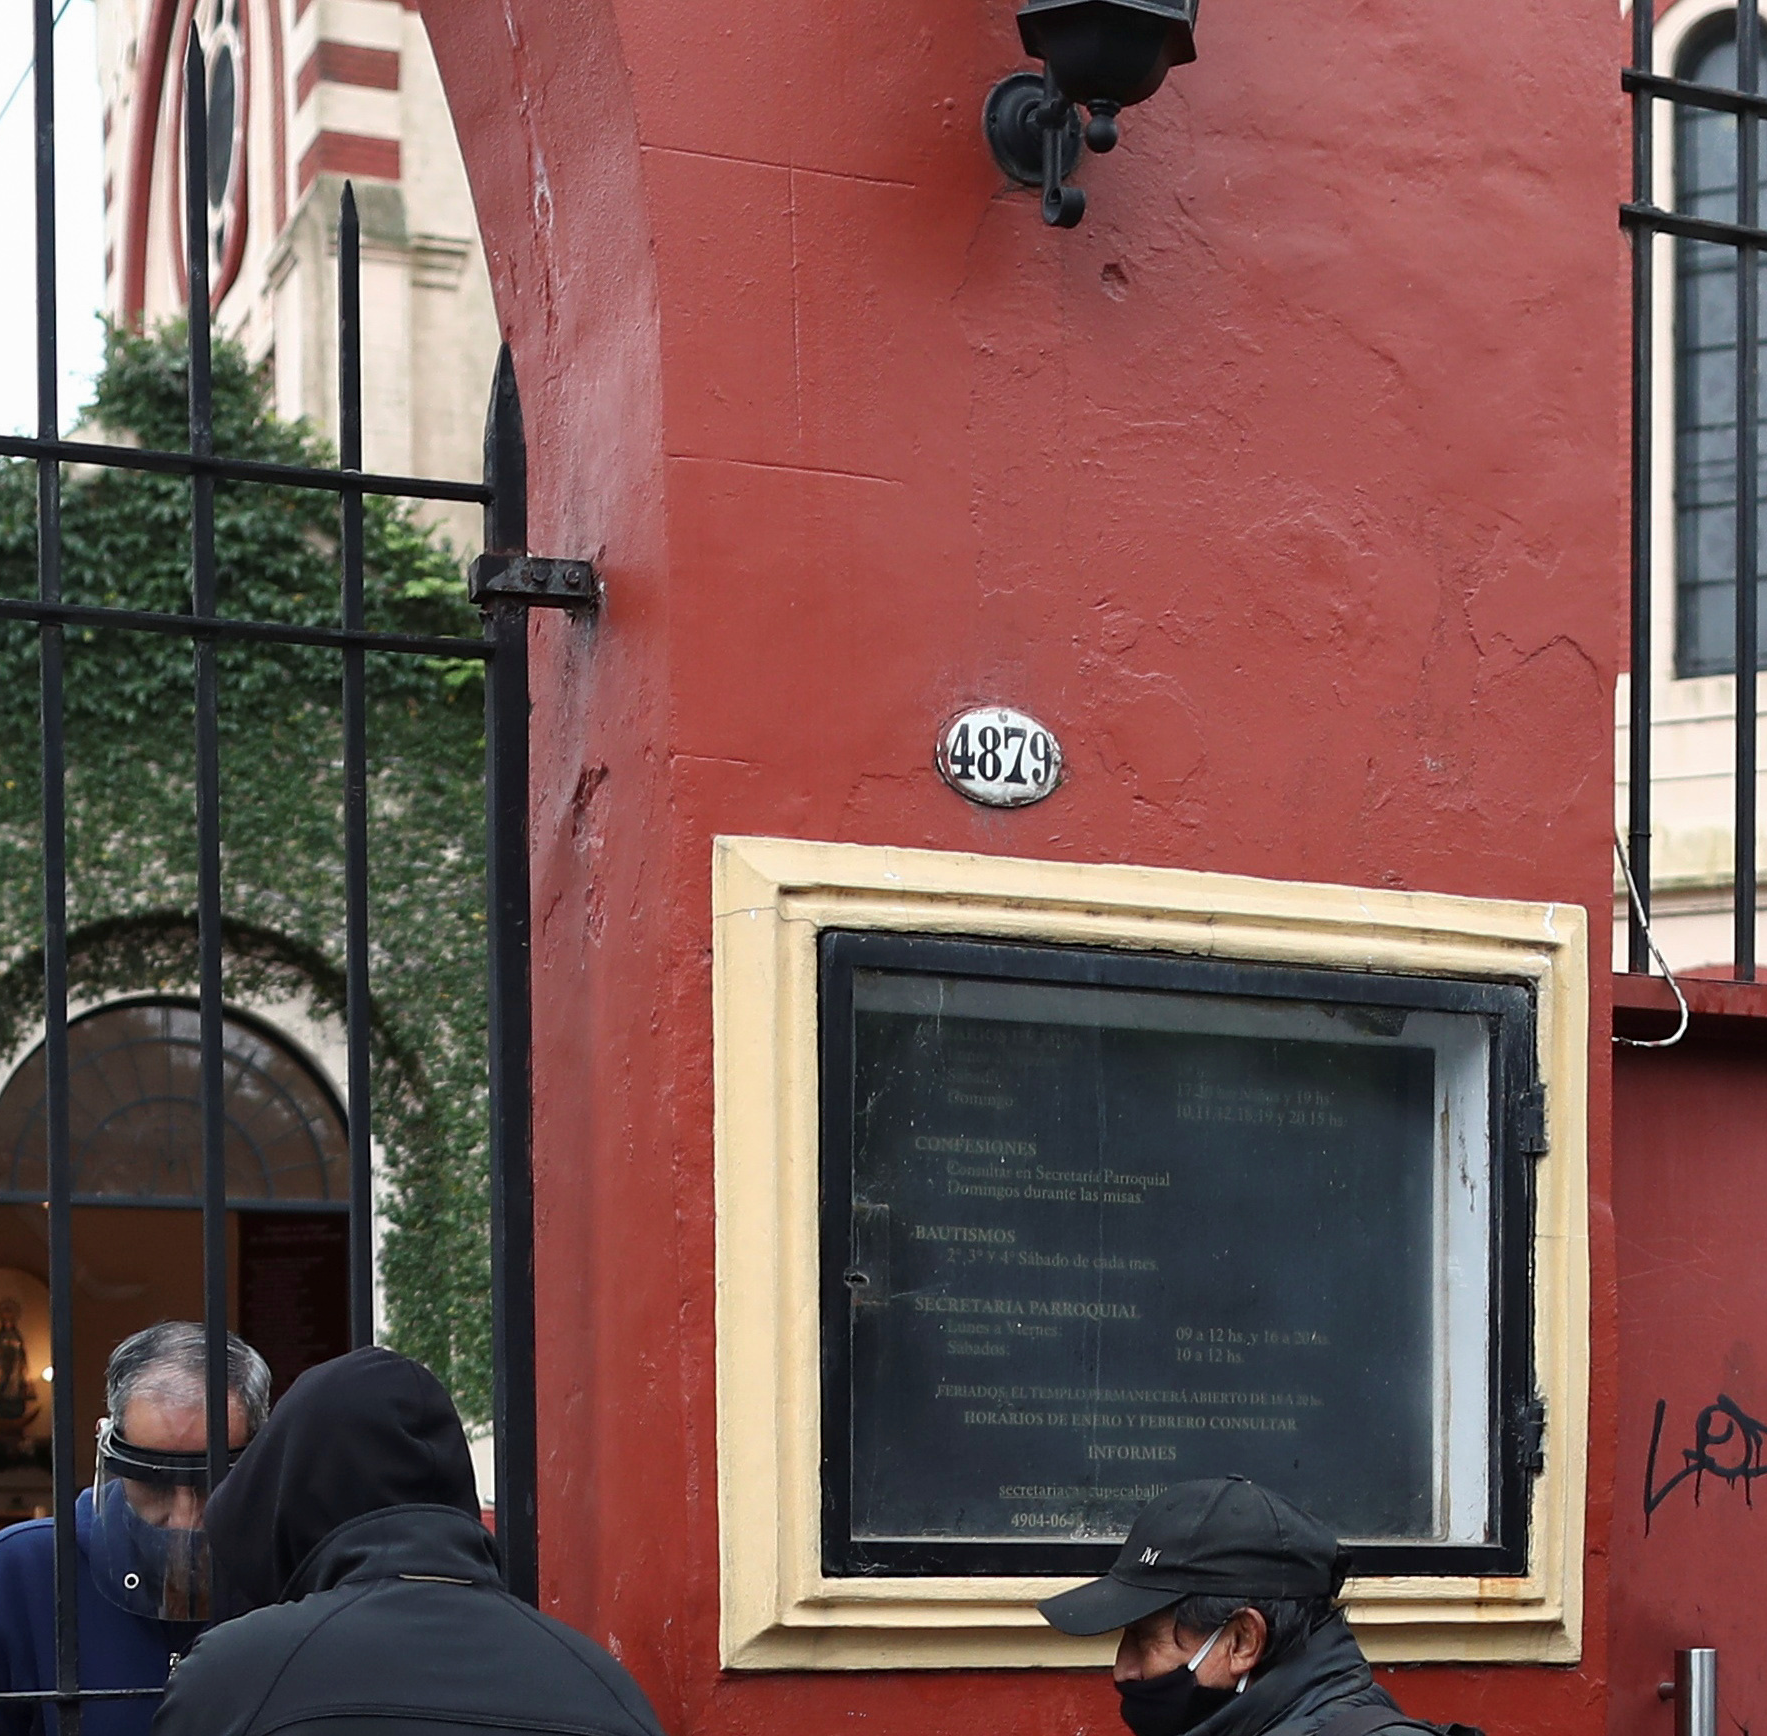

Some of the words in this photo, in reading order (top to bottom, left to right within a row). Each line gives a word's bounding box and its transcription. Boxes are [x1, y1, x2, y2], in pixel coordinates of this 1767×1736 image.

[951, 723, 1051, 785] 4879
[915, 1136, 1037, 1156] CONFESIONES
[947, 1160, 1012, 1179] Consultar
[1015, 1168, 1031, 1179] en
[1104, 1168, 1170, 1190] Parroquial
[947, 1179, 1020, 1199] Domingos
[1024, 1183, 1076, 1201] durante
[1080, 1187, 1099, 1202] las
[915, 1224, 1016, 1243] BAUTISMOS
[1073, 1253, 1089, 1269] de
[1093, 1255, 1124, 1270] cada
[1029, 1301, 1141, 1321] PARROQUIAL
[1176, 1326, 1193, 1341] 09
[1196, 1331, 1204, 1342] a
[1209, 1328, 1224, 1343] 12
[1250, 1332, 1258, 1347] y
[1176, 1347, 1192, 1362] 10
[1195, 1351, 1203, 1362] a
[1209, 1348, 1223, 1363] 12
[1030, 1386, 1085, 1399] TEMPLO
[1190, 1391, 1247, 1405] ABIERTO
[1250, 1392, 1267, 1405] DE
[964, 1411, 1044, 1425] HORARIOS
[1047, 1412, 1068, 1426] DE
[1072, 1413, 1121, 1427] ENERO
[1125, 1414, 1136, 1427] Y
[1140, 1414, 1205, 1429] FEBRERO
[1210, 1416, 1297, 1431] CONSULTAR
[1088, 1445, 1177, 1460] INFORMES
